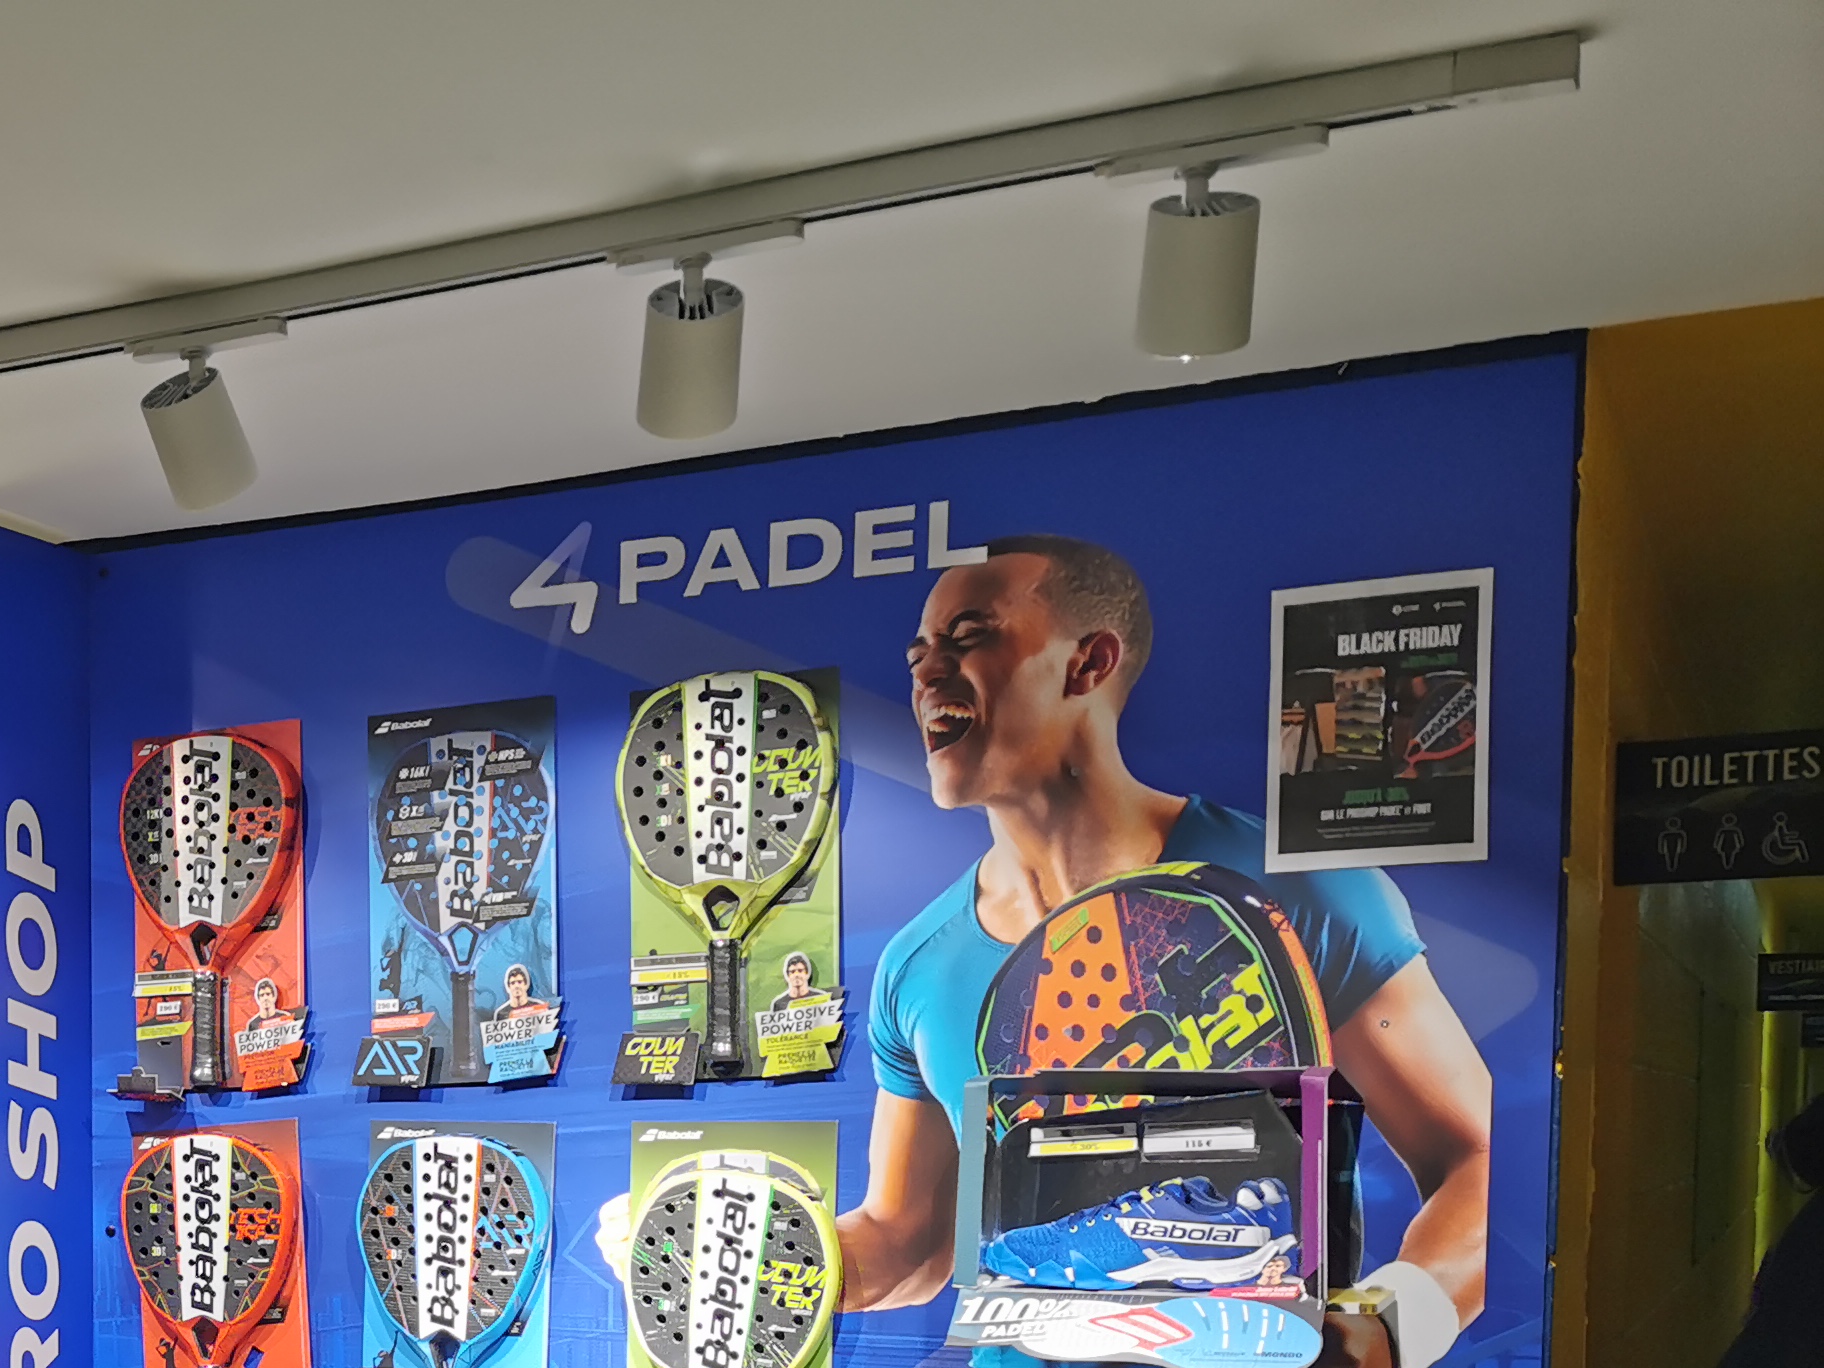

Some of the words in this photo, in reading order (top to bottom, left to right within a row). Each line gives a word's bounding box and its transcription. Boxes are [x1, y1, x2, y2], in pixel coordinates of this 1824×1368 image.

[1337, 630, 1397, 656] BLACK
[1399, 624, 1463, 651] FRIDAY
[705, 679, 736, 876] Babolat
[1652, 746, 1822, 789] TOILETTES
[189, 739, 220, 919] Babolat
[447, 738, 475, 920] Babolat
[6, 798, 59, 1191] SHOP
[485, 1014, 552, 1034] EXPLOSIVE
[761, 1005, 835, 1025] EXPLOSIVE
[238, 1024, 298, 1043] EXPLOSIVE
[486, 1030, 533, 1045] POWER
[761, 1021, 813, 1037] POWER
[239, 1038, 280, 1053] POWER
[357, 1040, 423, 1076] AIR
[639, 1056, 680, 1074] TER
[658, 1130, 703, 1140] Babolat
[190, 1138, 216, 1314] Babolat
[430, 1142, 459, 1329] Babolat
[1131, 1221, 1246, 1242] Babolat
[956, 1297, 1076, 1323] 100%
[981, 1322, 1046, 1338] PADEL
